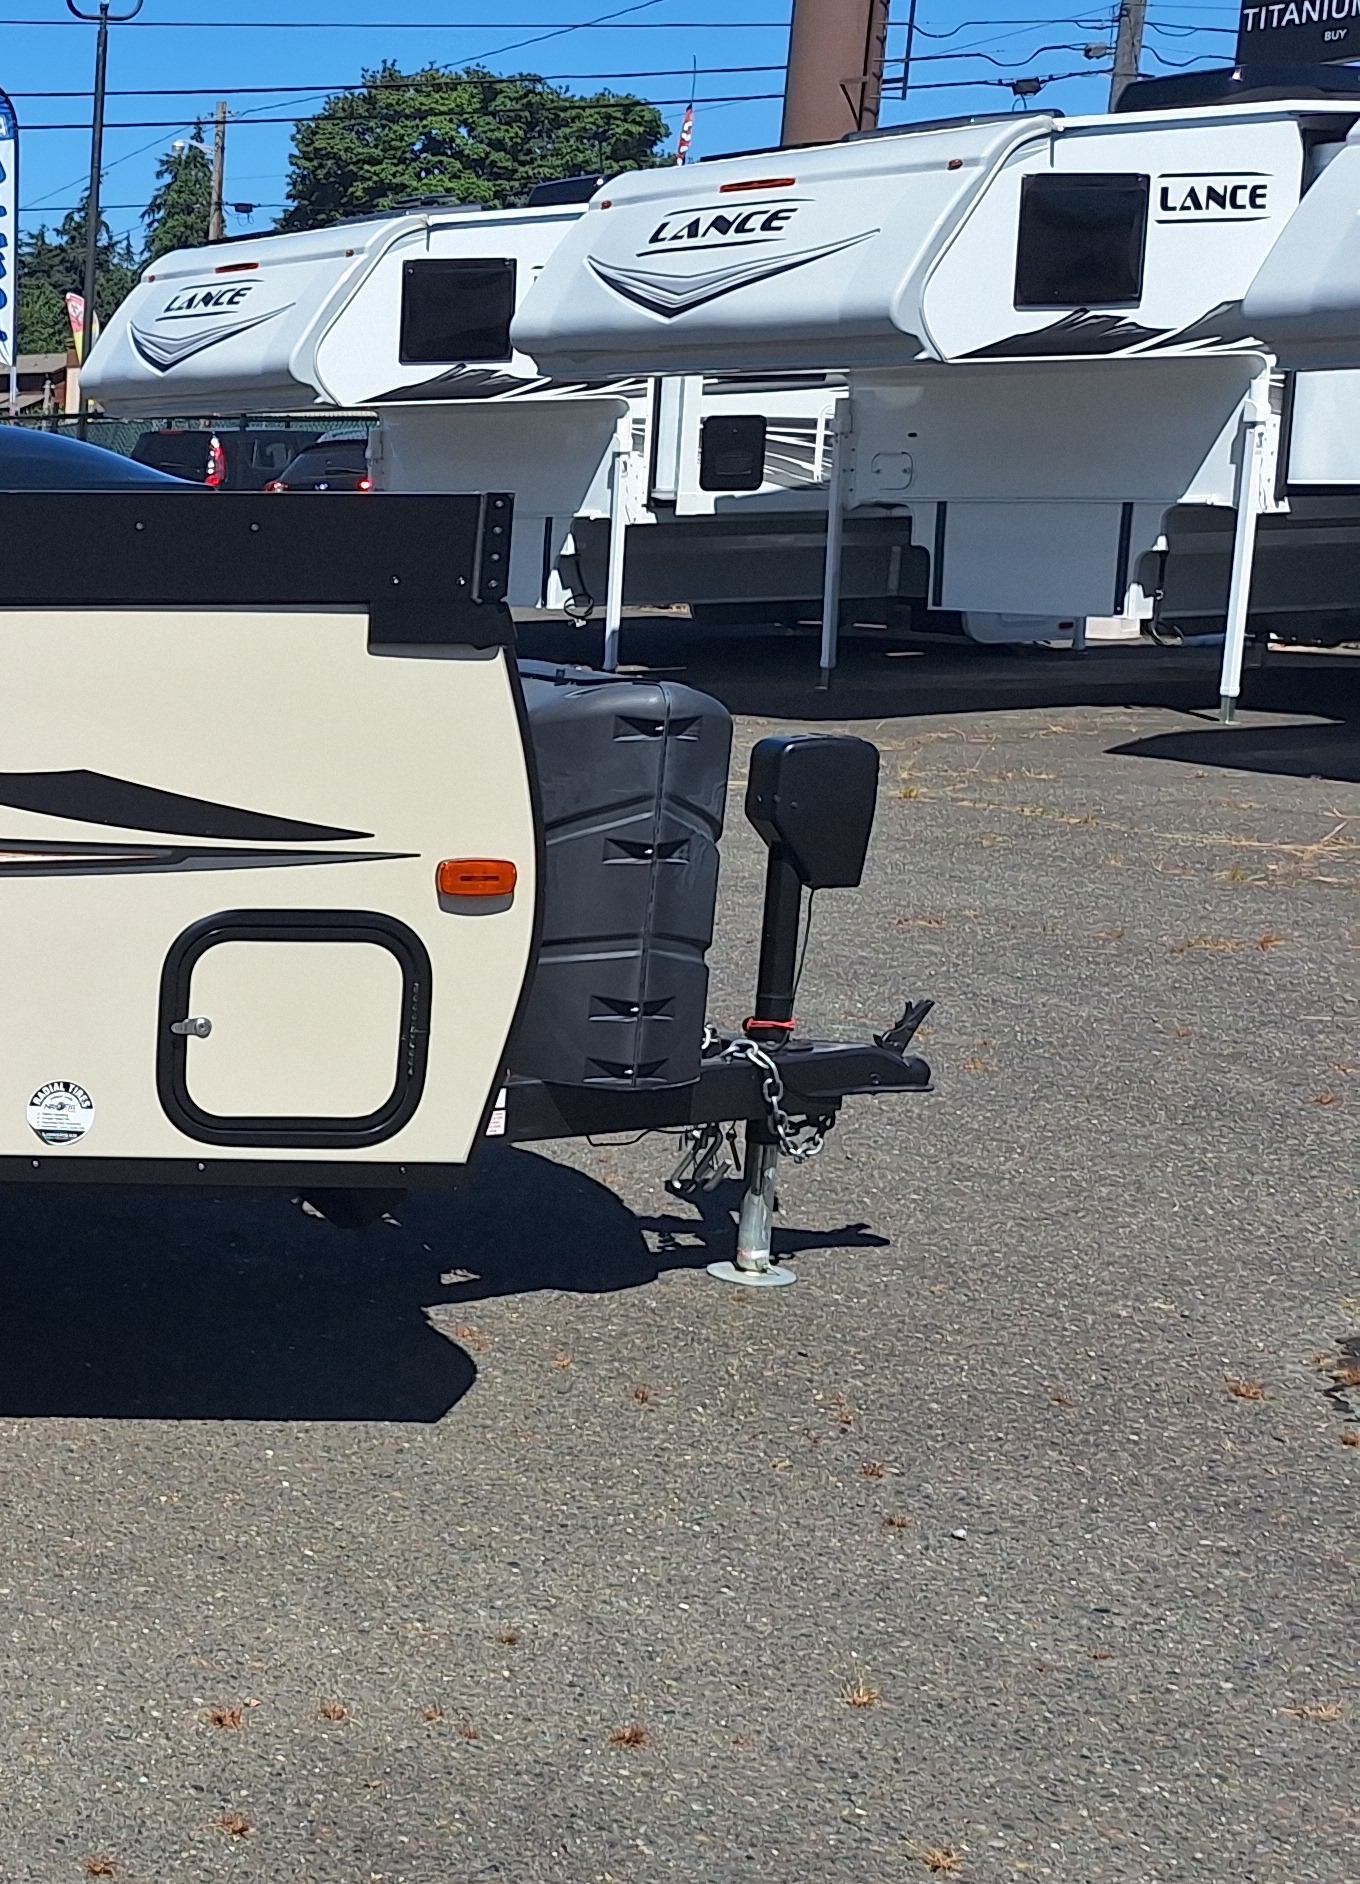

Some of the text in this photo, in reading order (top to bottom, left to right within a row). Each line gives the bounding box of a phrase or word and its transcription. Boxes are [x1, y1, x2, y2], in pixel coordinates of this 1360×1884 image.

[1324, 28, 1348, 41] BUY
[1160, 184, 1268, 211] LANCE
[648, 208, 799, 245] LANCE
[163, 287, 253, 314] LANCE
[32, 1082, 91, 1108] RADIAL TIRES
